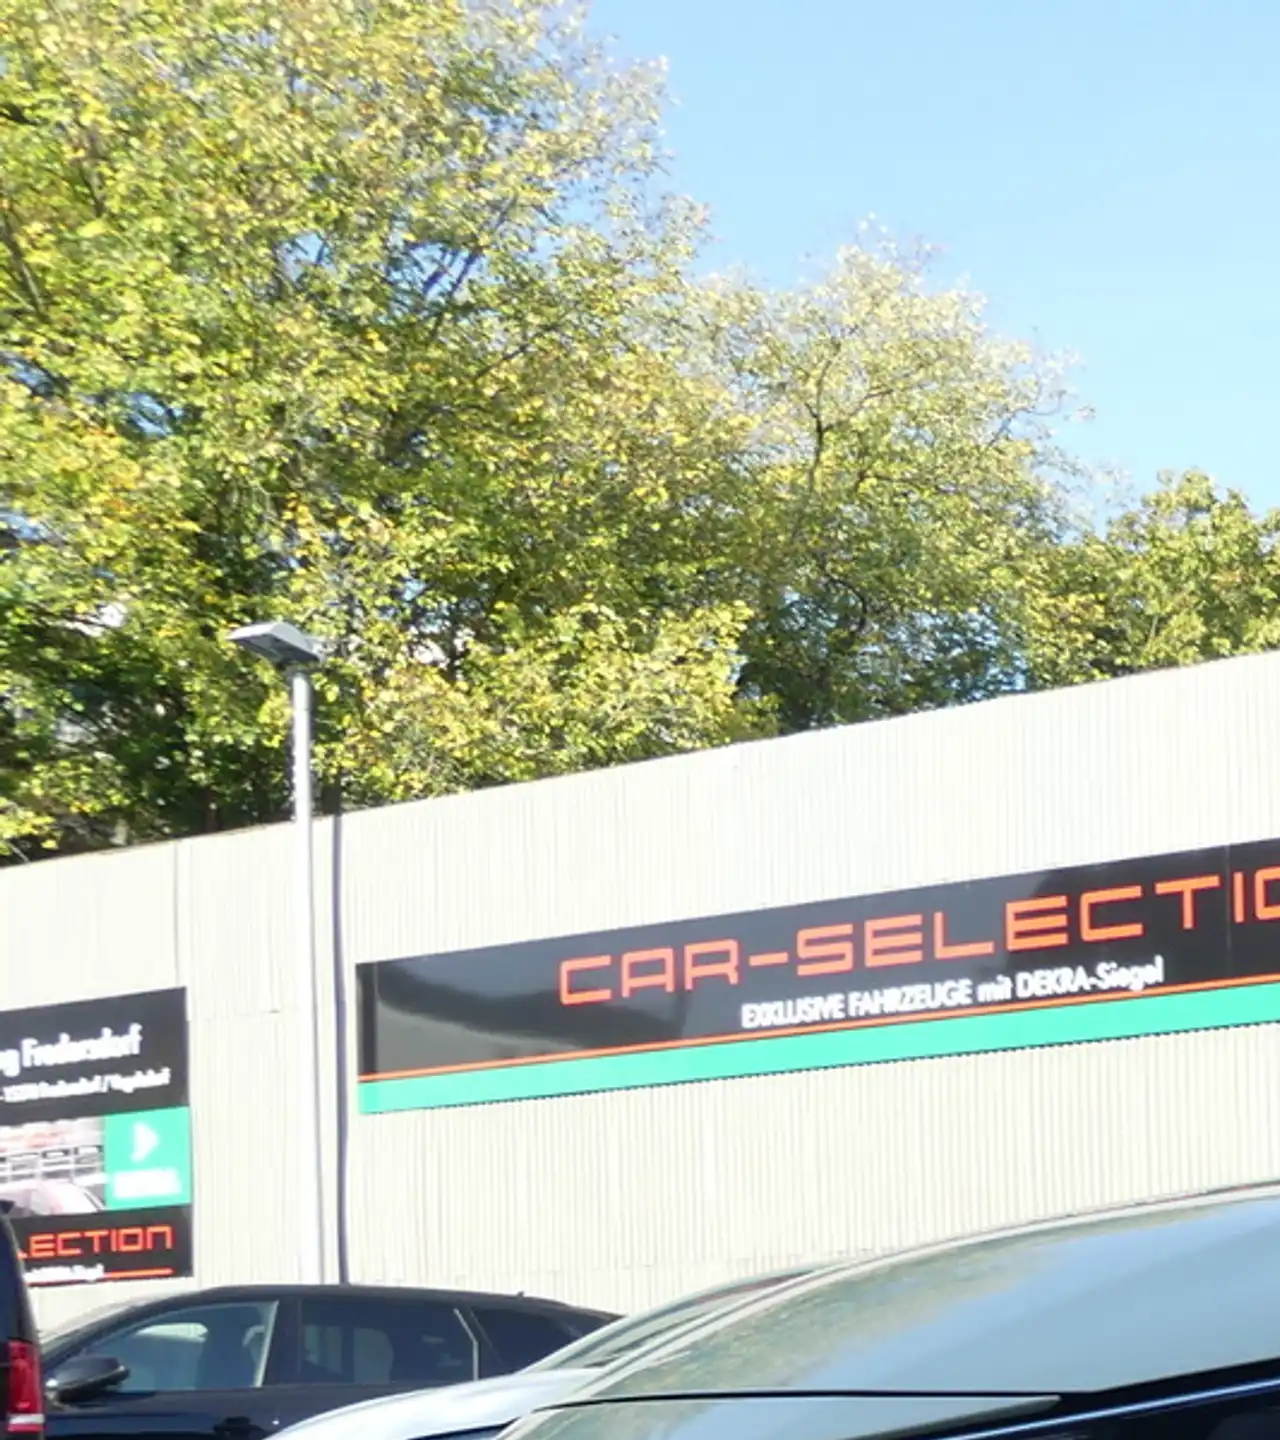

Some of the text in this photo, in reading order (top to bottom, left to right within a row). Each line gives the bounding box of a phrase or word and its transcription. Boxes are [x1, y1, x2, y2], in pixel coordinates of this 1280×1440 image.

[741, 954, 1165, 1029] EXKLUSIVE FAHRZEUGE mit DEKRA-Siegel
[17, 1224, 173, 1260] ECTION
